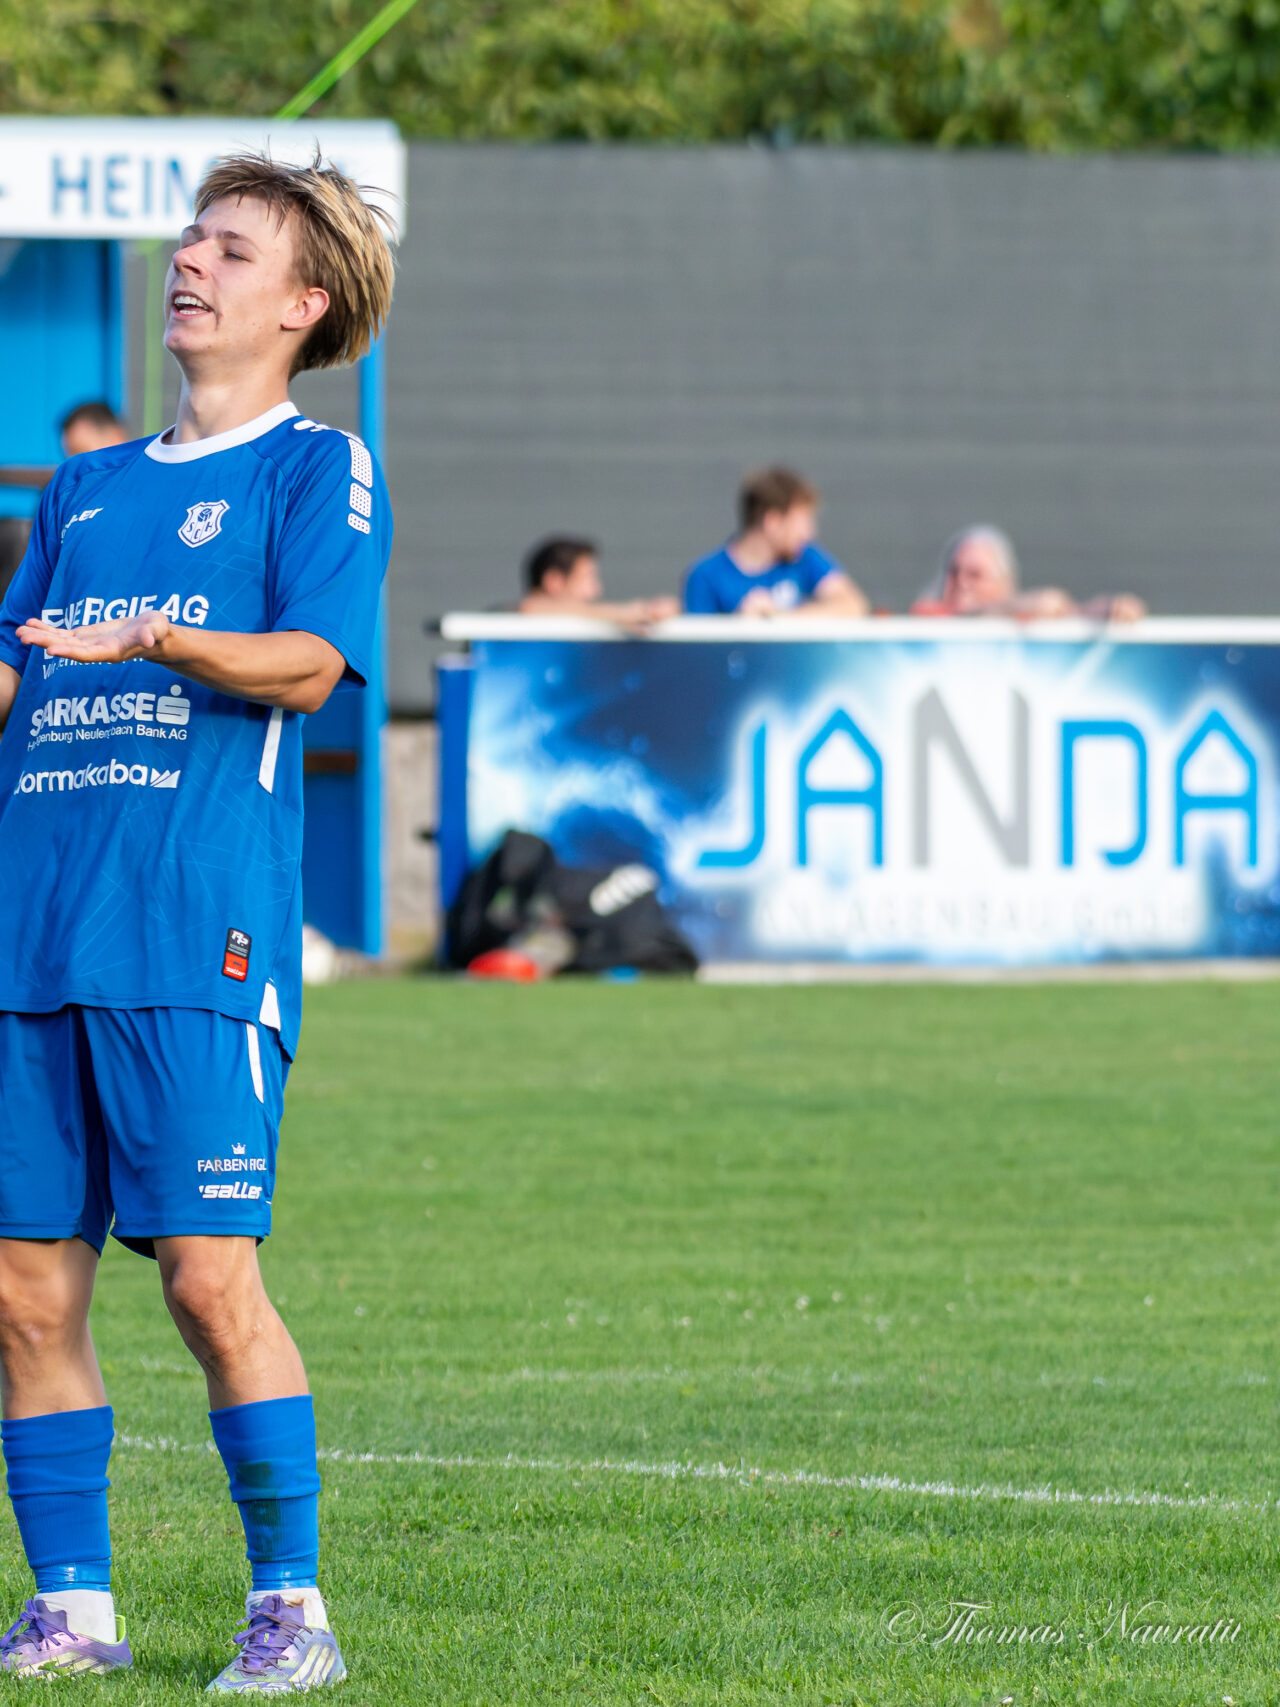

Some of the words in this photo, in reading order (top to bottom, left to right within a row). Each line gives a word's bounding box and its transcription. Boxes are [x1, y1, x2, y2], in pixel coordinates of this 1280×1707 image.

[159, 593, 210, 626] AG
[29, 692, 157, 737] SARKASSE
[136, 723, 167, 739] Bank
[169, 728, 188, 741] AG
[696, 685, 1261, 868] JANDA
[197, 1158, 248, 1172] FARBEN
